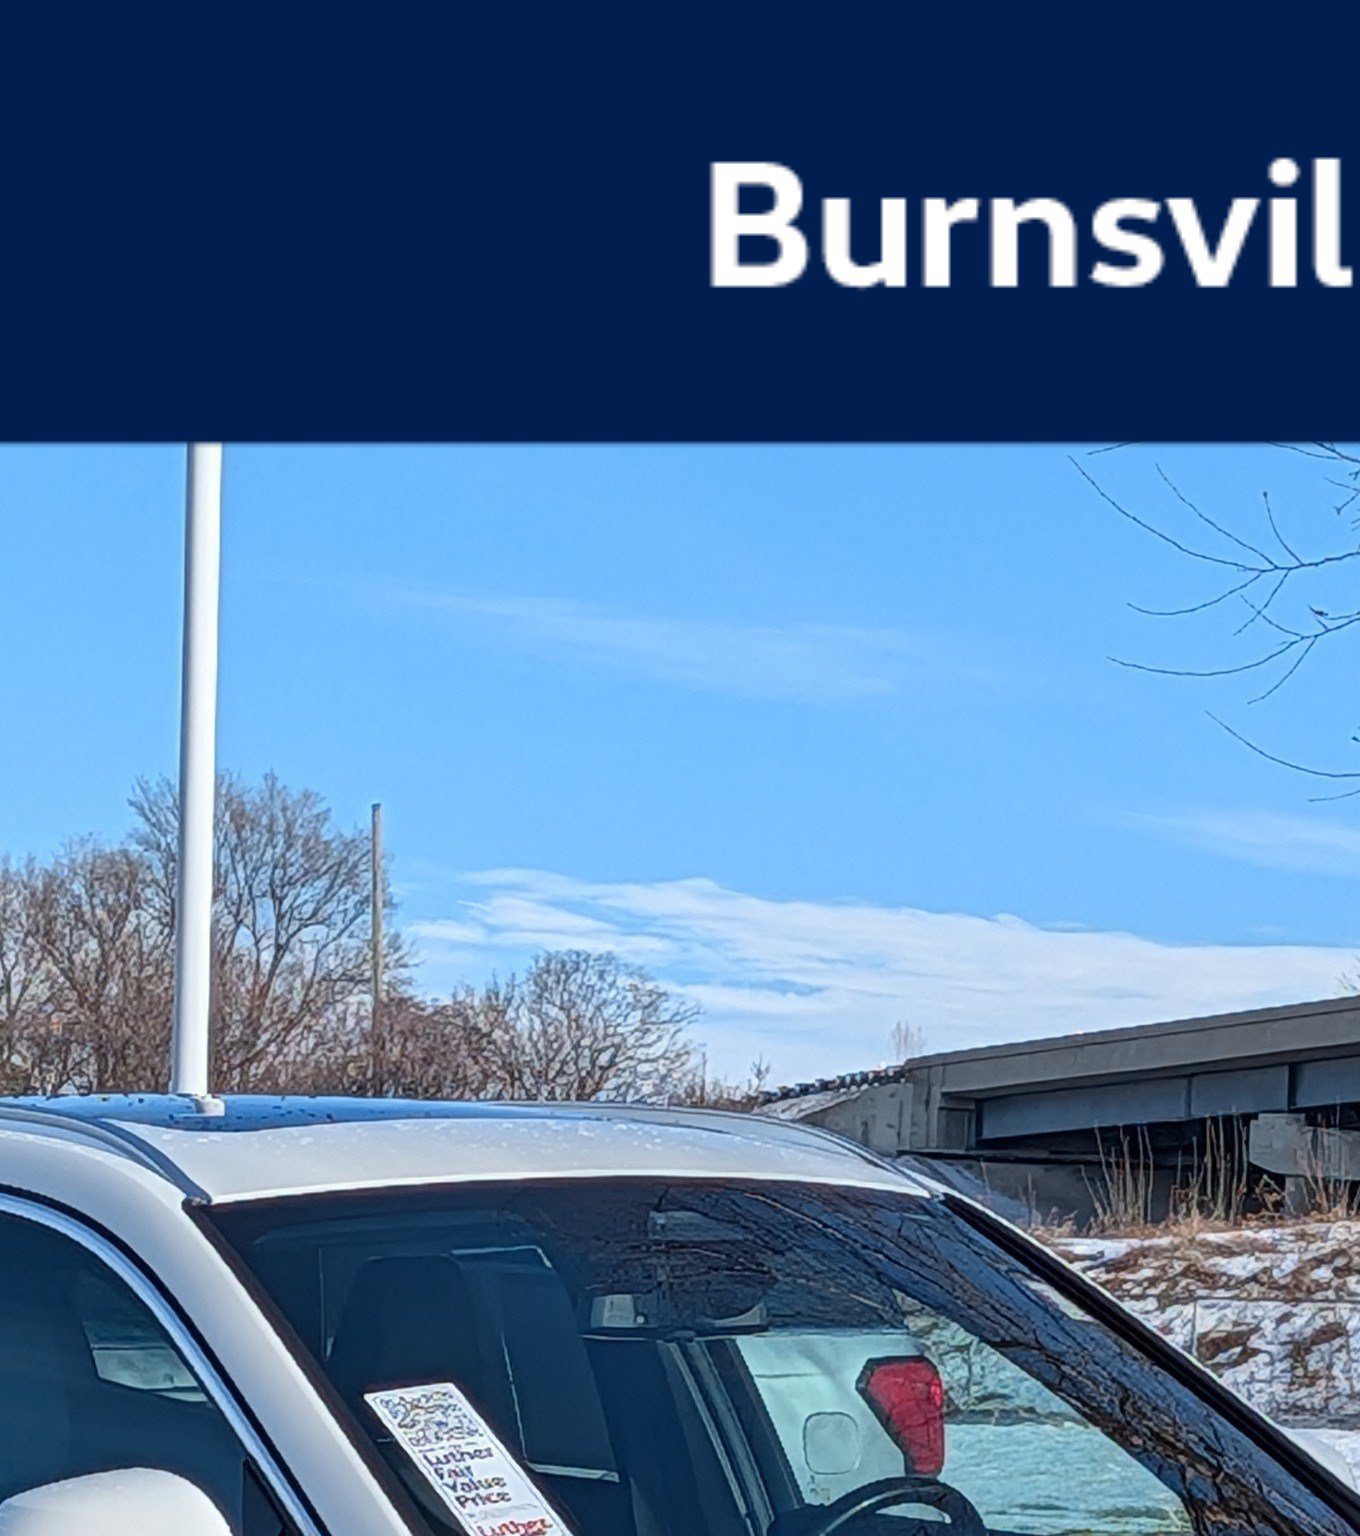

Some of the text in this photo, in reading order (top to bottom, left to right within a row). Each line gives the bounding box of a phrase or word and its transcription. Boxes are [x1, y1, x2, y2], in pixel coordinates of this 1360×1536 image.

[422, 1446, 494, 1467] Luther
[433, 1465, 474, 1480] Fair
[443, 1476, 507, 1493] Value
[454, 1491, 512, 1509] Price
